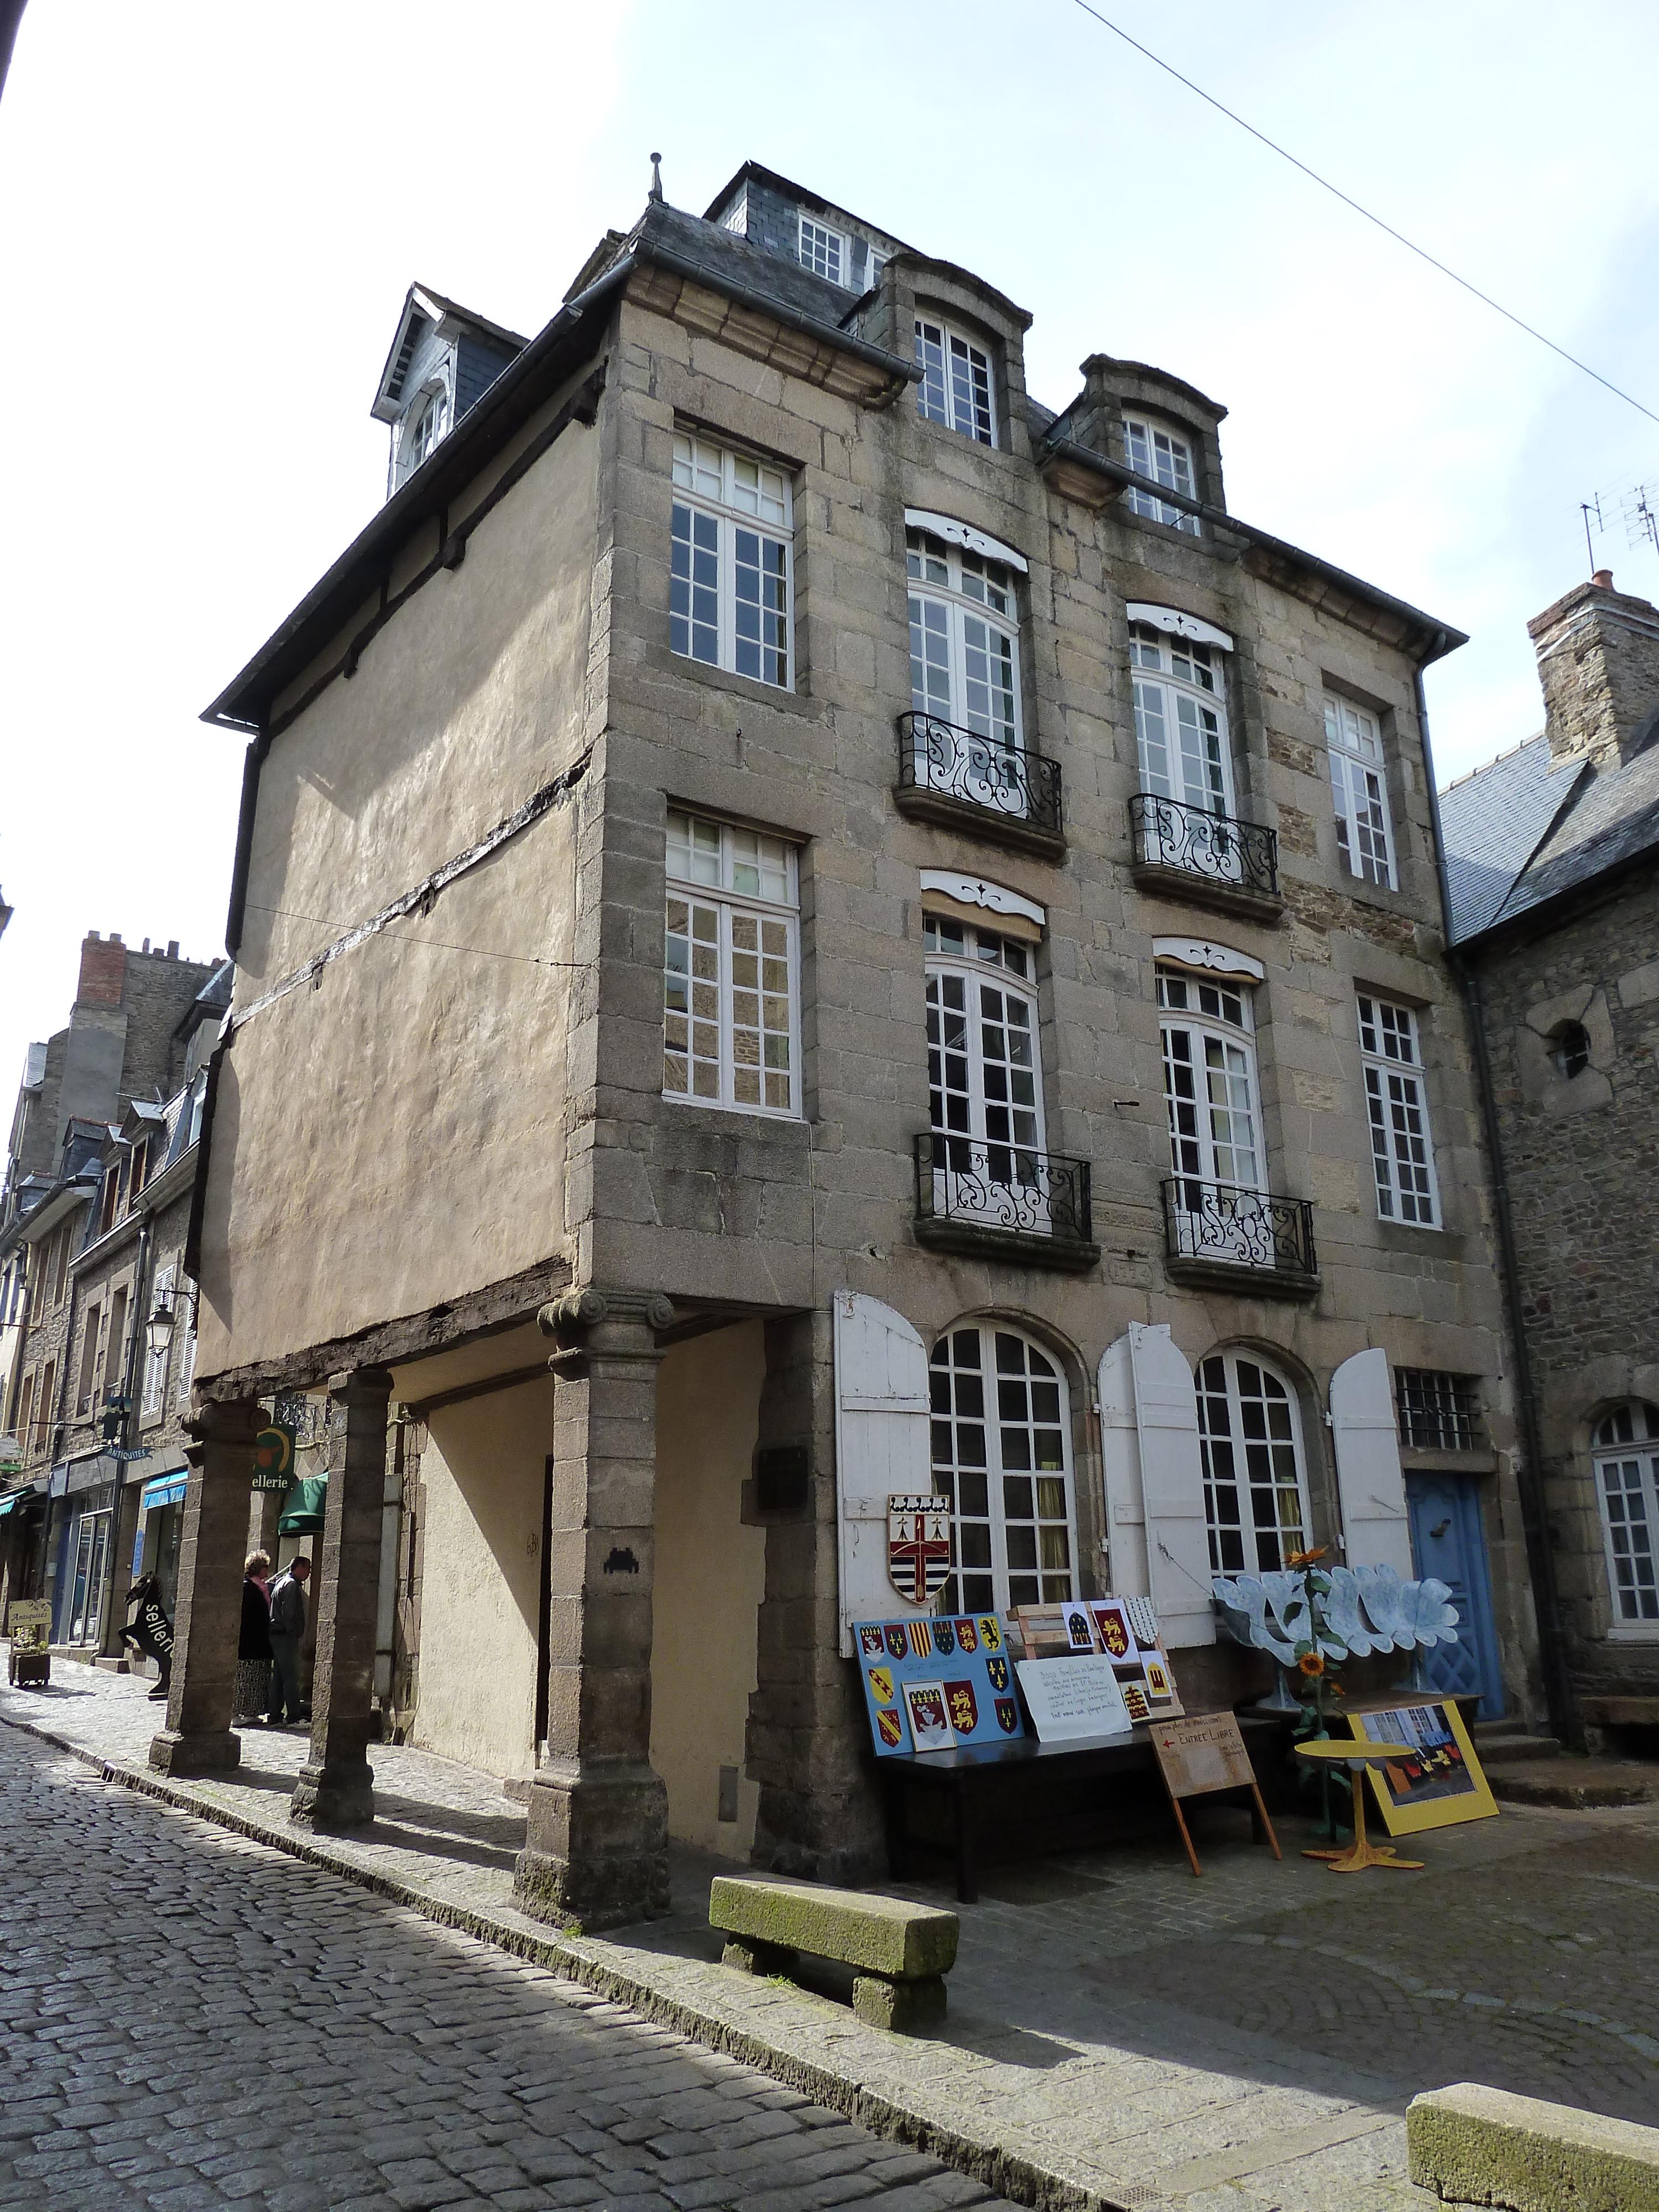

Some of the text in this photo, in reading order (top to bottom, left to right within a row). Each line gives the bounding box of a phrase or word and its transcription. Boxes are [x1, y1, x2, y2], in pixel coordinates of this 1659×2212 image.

[107, 1448, 145, 1460] ANTIQUITES
[252, 1474, 288, 1488] ellerie
[1209, 1729, 1235, 1740] LIBRE
